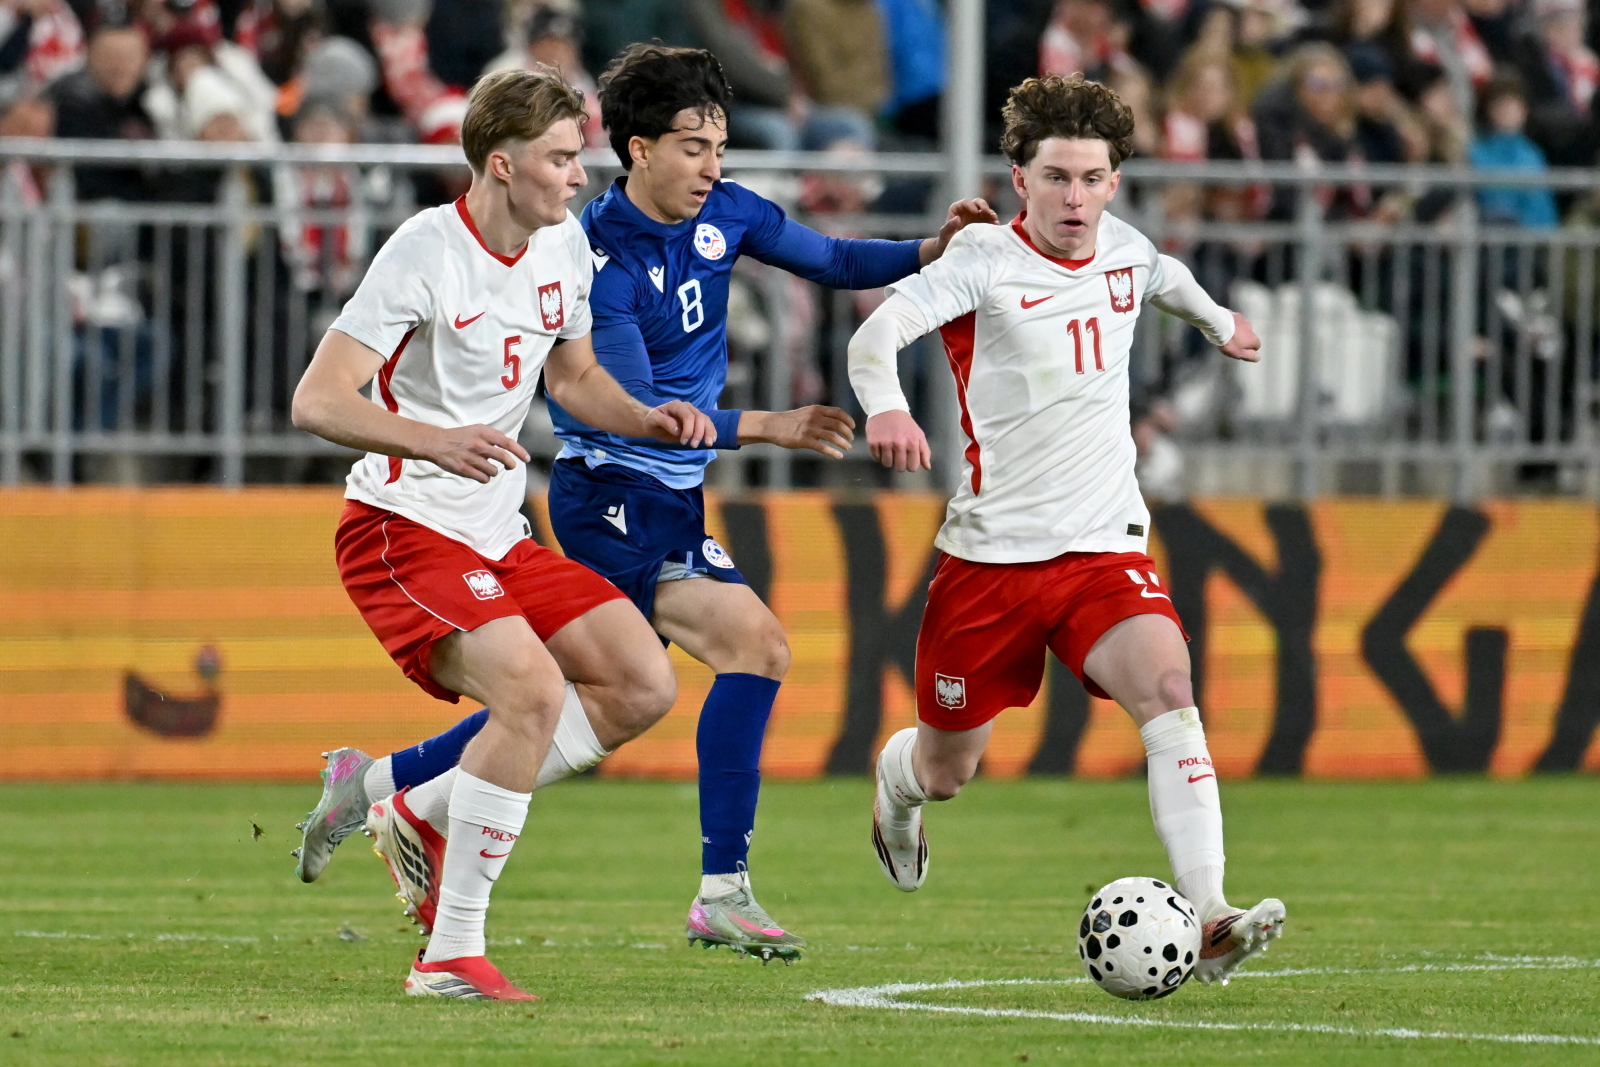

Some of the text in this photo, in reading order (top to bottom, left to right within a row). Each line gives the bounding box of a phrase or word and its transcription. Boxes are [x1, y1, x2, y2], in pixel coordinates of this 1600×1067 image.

[677, 278, 704, 333] 8
[500, 335, 521, 390] 5
[1066, 317, 1105, 374] 11
[481, 826, 517, 841] POLS
